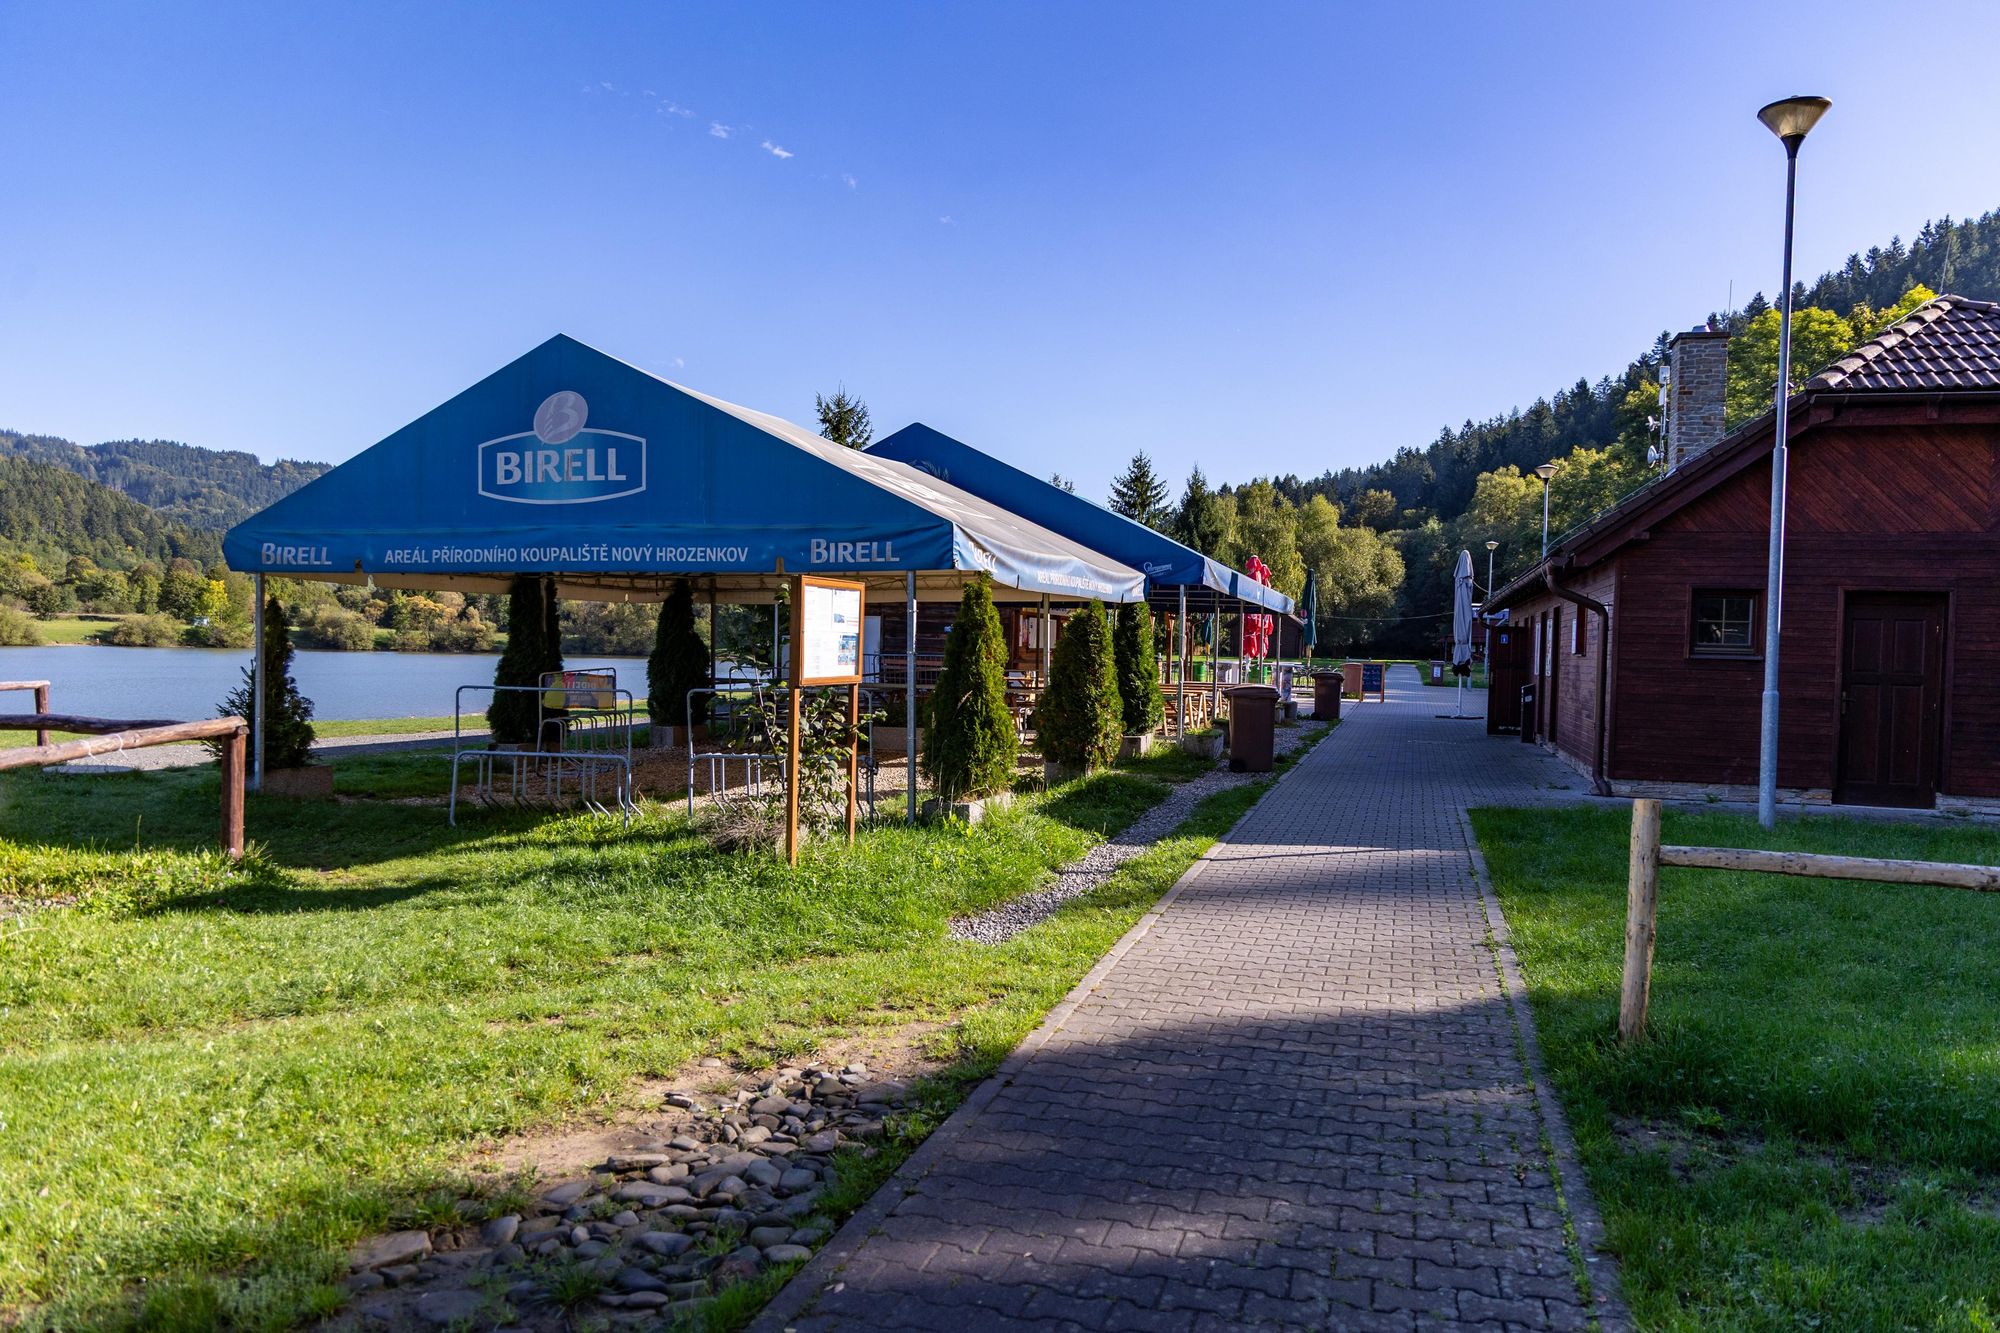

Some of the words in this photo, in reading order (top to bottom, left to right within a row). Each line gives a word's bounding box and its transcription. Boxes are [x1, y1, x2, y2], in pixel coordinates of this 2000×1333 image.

[496, 448, 627, 485] BIRELL
[261, 542, 332, 565] BIRELL
[384, 546, 429, 564] AREÁL
[432, 545, 517, 564] PŘÍRODNÍHO
[520, 544, 609, 562] KOUPALIŠTĚ
[611, 544, 653, 562] NOVÝ
[656, 547, 749, 562] HROZENKOV
[810, 538, 900, 564] BIRELL
